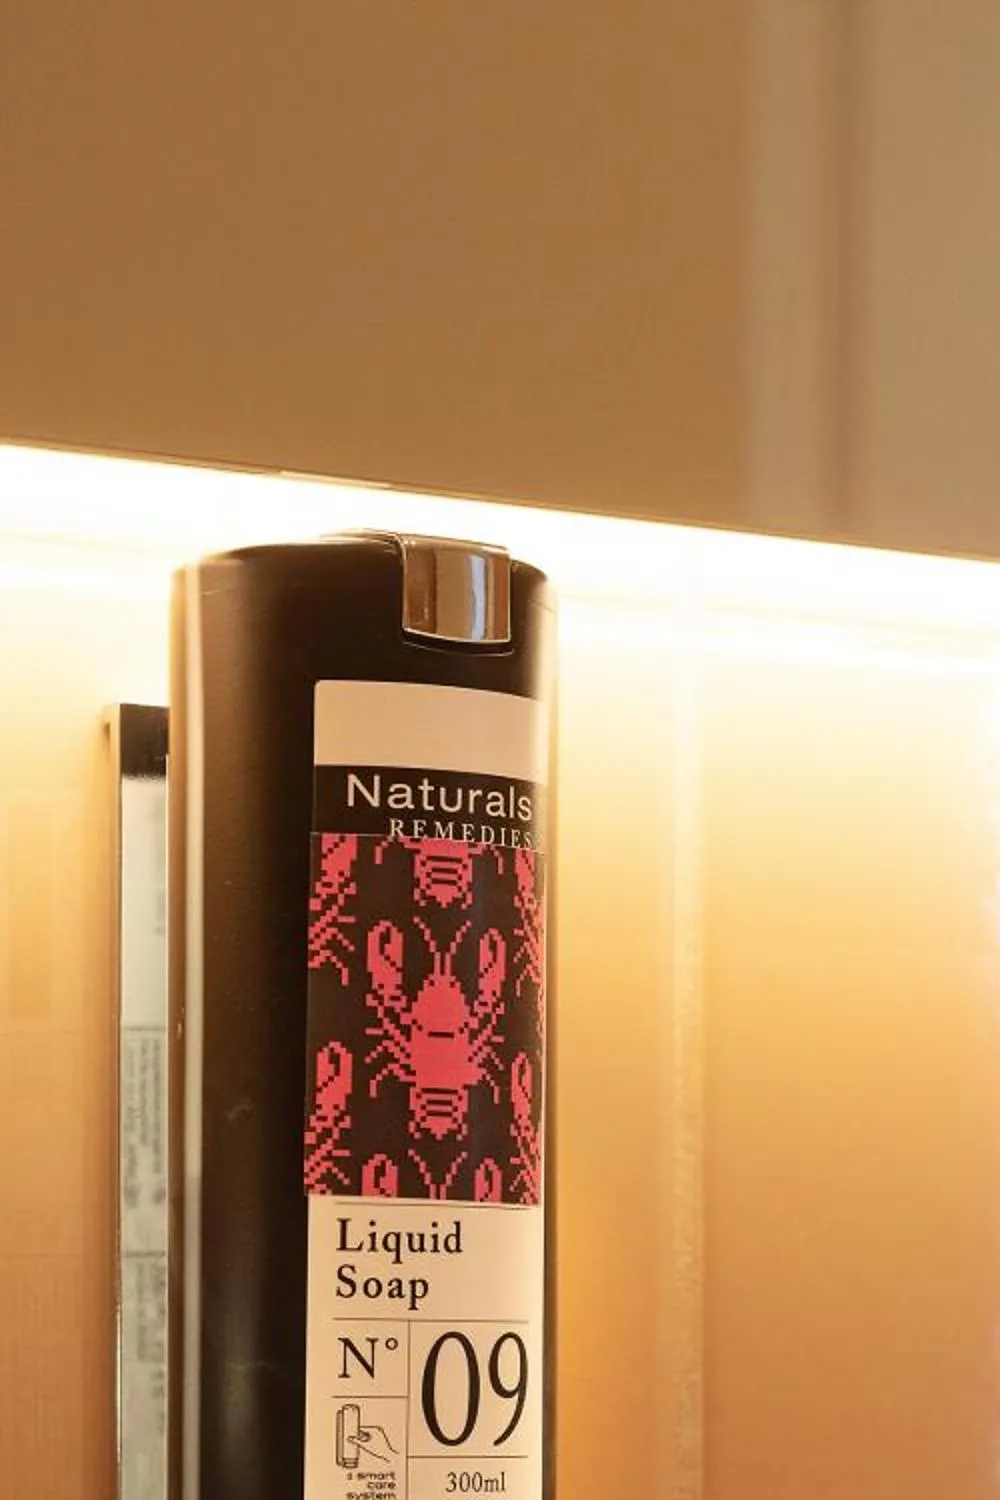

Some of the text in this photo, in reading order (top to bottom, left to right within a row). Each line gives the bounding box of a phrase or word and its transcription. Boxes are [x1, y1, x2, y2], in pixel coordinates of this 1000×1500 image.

[347, 773, 534, 821] Naturals
[389, 818, 533, 849] REMEDIES
[336, 1217, 464, 1264] Liquid
[335, 1264, 430, 1311] Soap
[337, 1331, 529, 1446] N° 09
[357, 1472, 396, 1481] smart
[367, 1482, 397, 1490] care
[446, 1471, 506, 1494] 300ml
